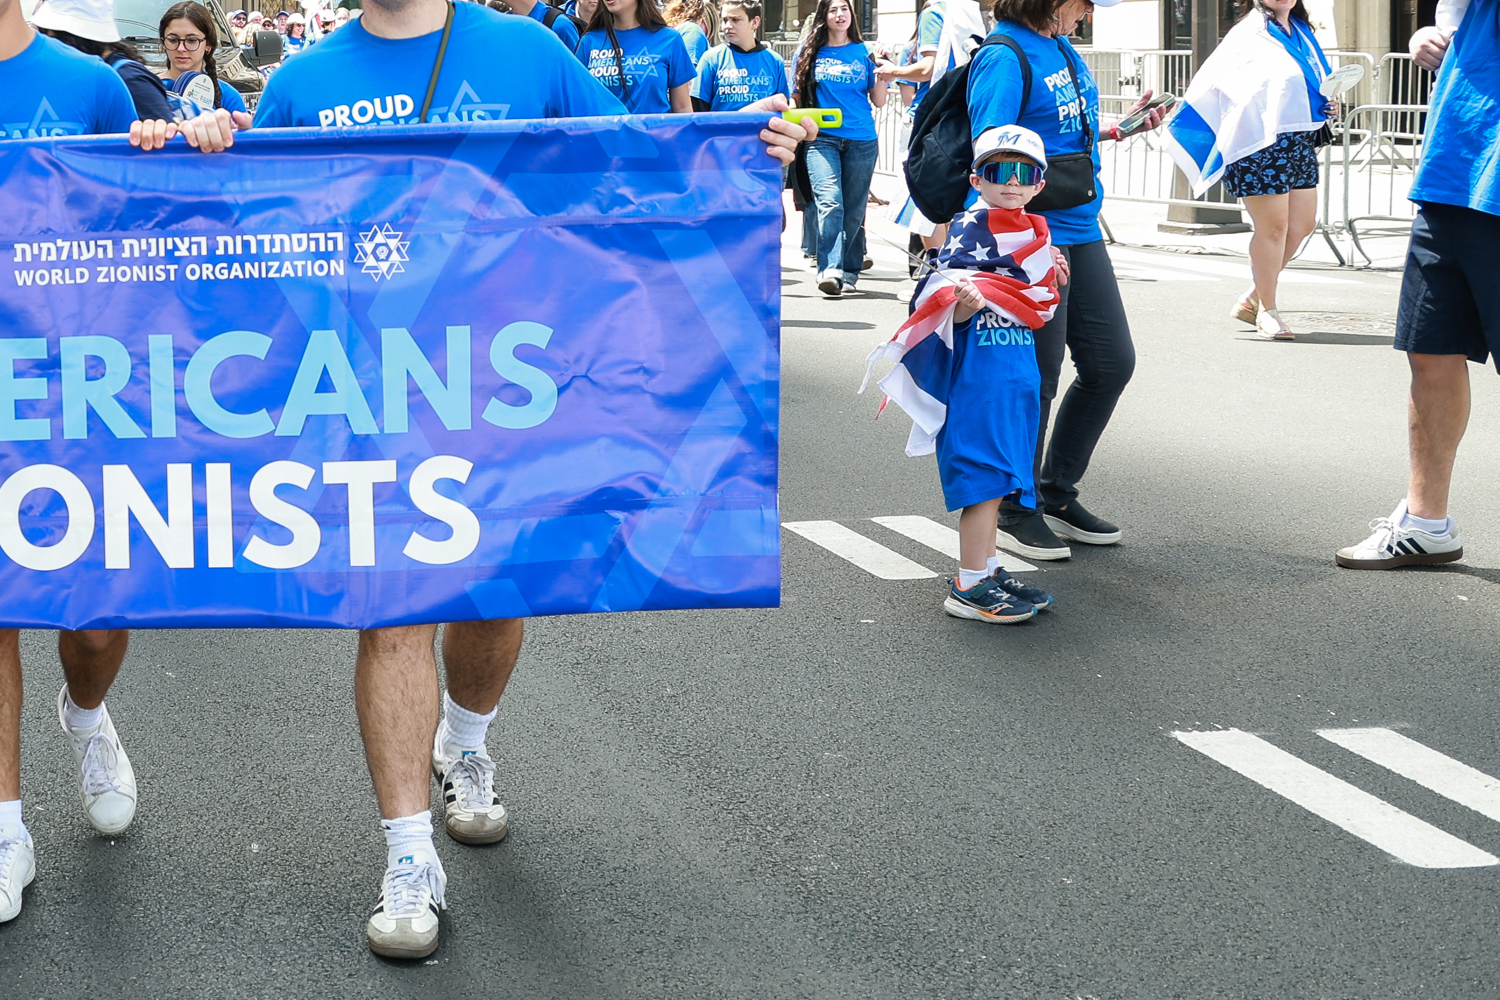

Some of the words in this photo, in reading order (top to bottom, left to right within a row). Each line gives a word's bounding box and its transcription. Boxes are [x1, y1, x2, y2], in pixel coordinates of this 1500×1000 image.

[590, 48, 624, 60] ROUD
[717, 68, 748, 78] PROUD
[718, 76, 770, 86] AMERICANS
[1044, 66, 1072, 92] PRO
[719, 85, 750, 94] PROUD
[720, 94, 759, 103] ZIONISTS
[318, 94, 415, 129] PROUD
[13, 238, 114, 263] העולמית
[122, 236, 208, 258] הציונית
[215, 232, 345, 255] ההסתדרות
[14, 267, 90, 286] WORLD
[96, 263, 179, 284] ZIONIST
[185, 259, 346, 281] ORGANIZATION
[976, 312, 1022, 330] PRO
